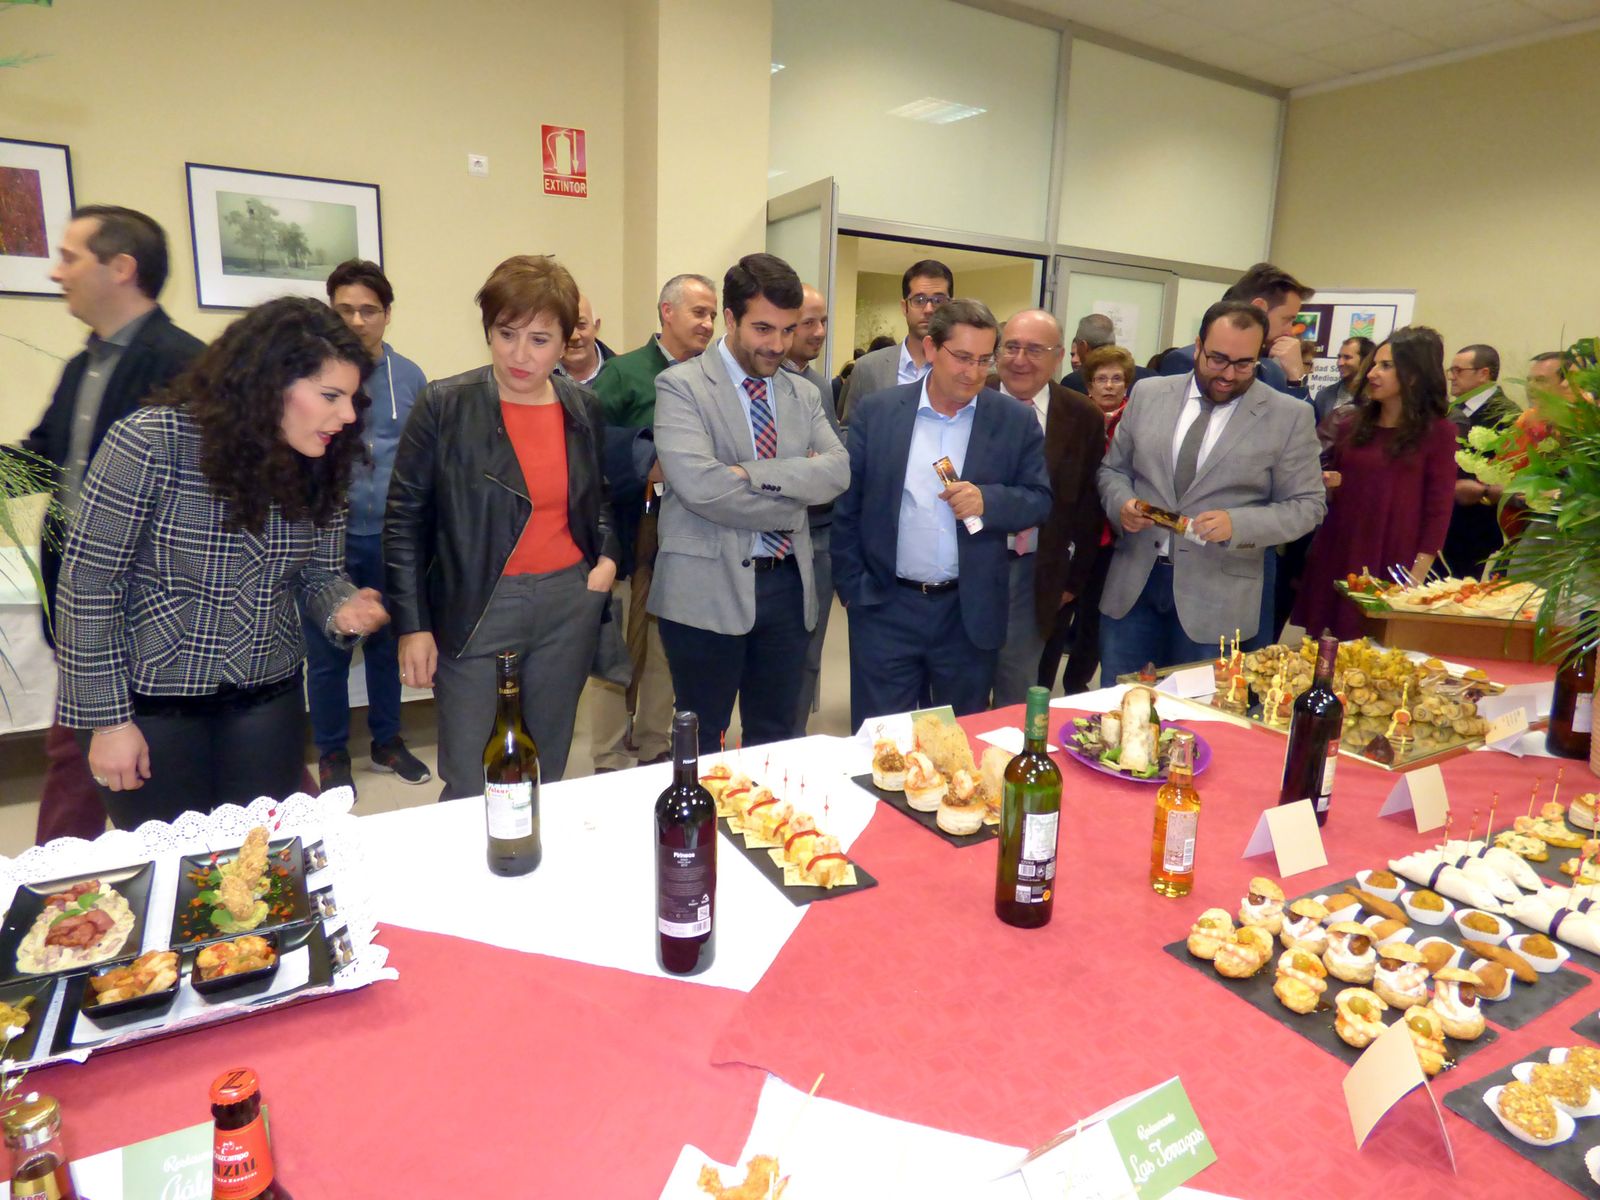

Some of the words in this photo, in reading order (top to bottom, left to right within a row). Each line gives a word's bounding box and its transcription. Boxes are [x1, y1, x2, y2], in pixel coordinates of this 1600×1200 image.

[545, 178, 587, 194] EXTINTOR
[219, 1070, 247, 1090] Z
[214, 1151, 249, 1161] ruzcampo
[1129, 1154, 1155, 1183] Las
